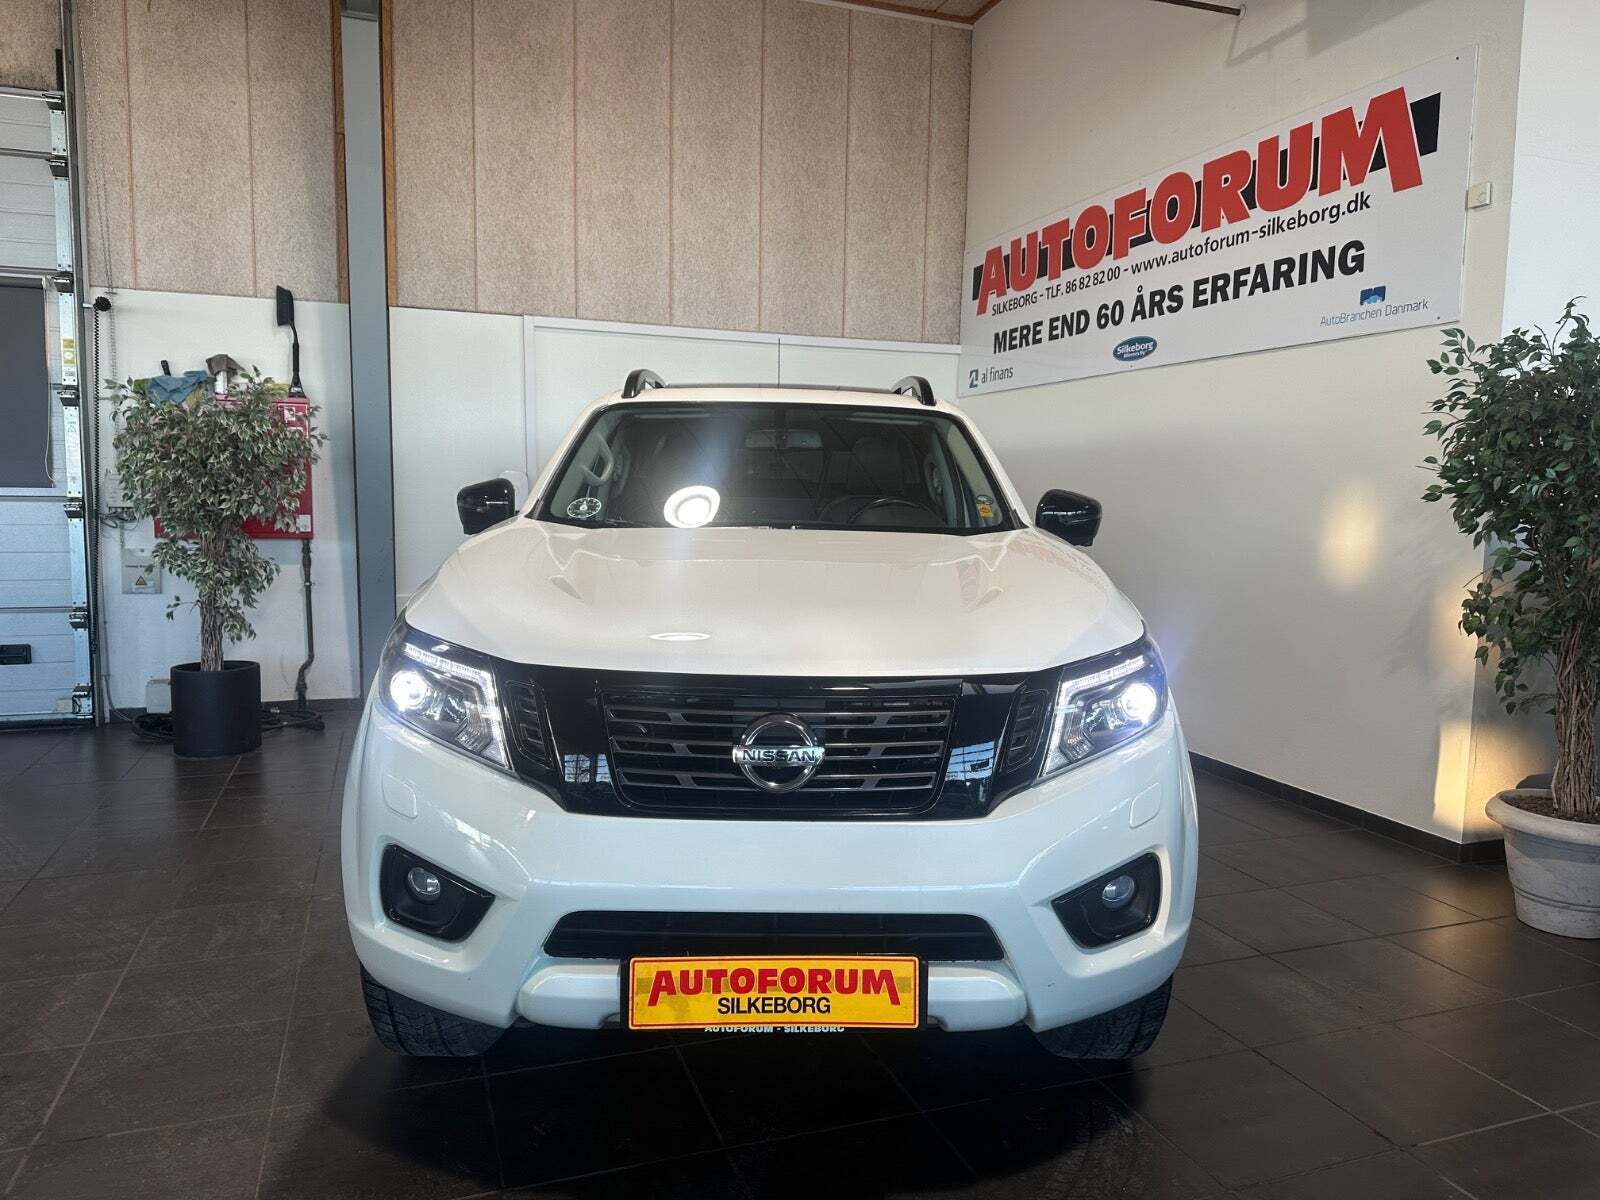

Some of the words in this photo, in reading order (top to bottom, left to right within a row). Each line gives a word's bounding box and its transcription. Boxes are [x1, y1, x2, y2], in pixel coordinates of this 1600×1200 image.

[976, 86, 1424, 316] AUTOFORUM
[992, 291, 1038, 316] SILKEBORG
[1045, 283, 1064, 300] TLF.
[1131, 190, 1371, 275] www.autoforum-silkeborg.dk
[993, 319, 1044, 354] MERE
[1047, 308, 1090, 342] END
[1096, 299, 1125, 330] 60
[1130, 284, 1184, 323] ÅRS
[1192, 239, 1366, 309] ERFARING
[1319, 308, 1382, 327] AutoBranchen
[1384, 298, 1429, 316] Danmark
[989, 366, 1014, 382] finans
[742, 748, 816, 763] NISSAN
[647, 967, 901, 1007] AUTOFORUM
[717, 996, 831, 1015] SILKEBORG
